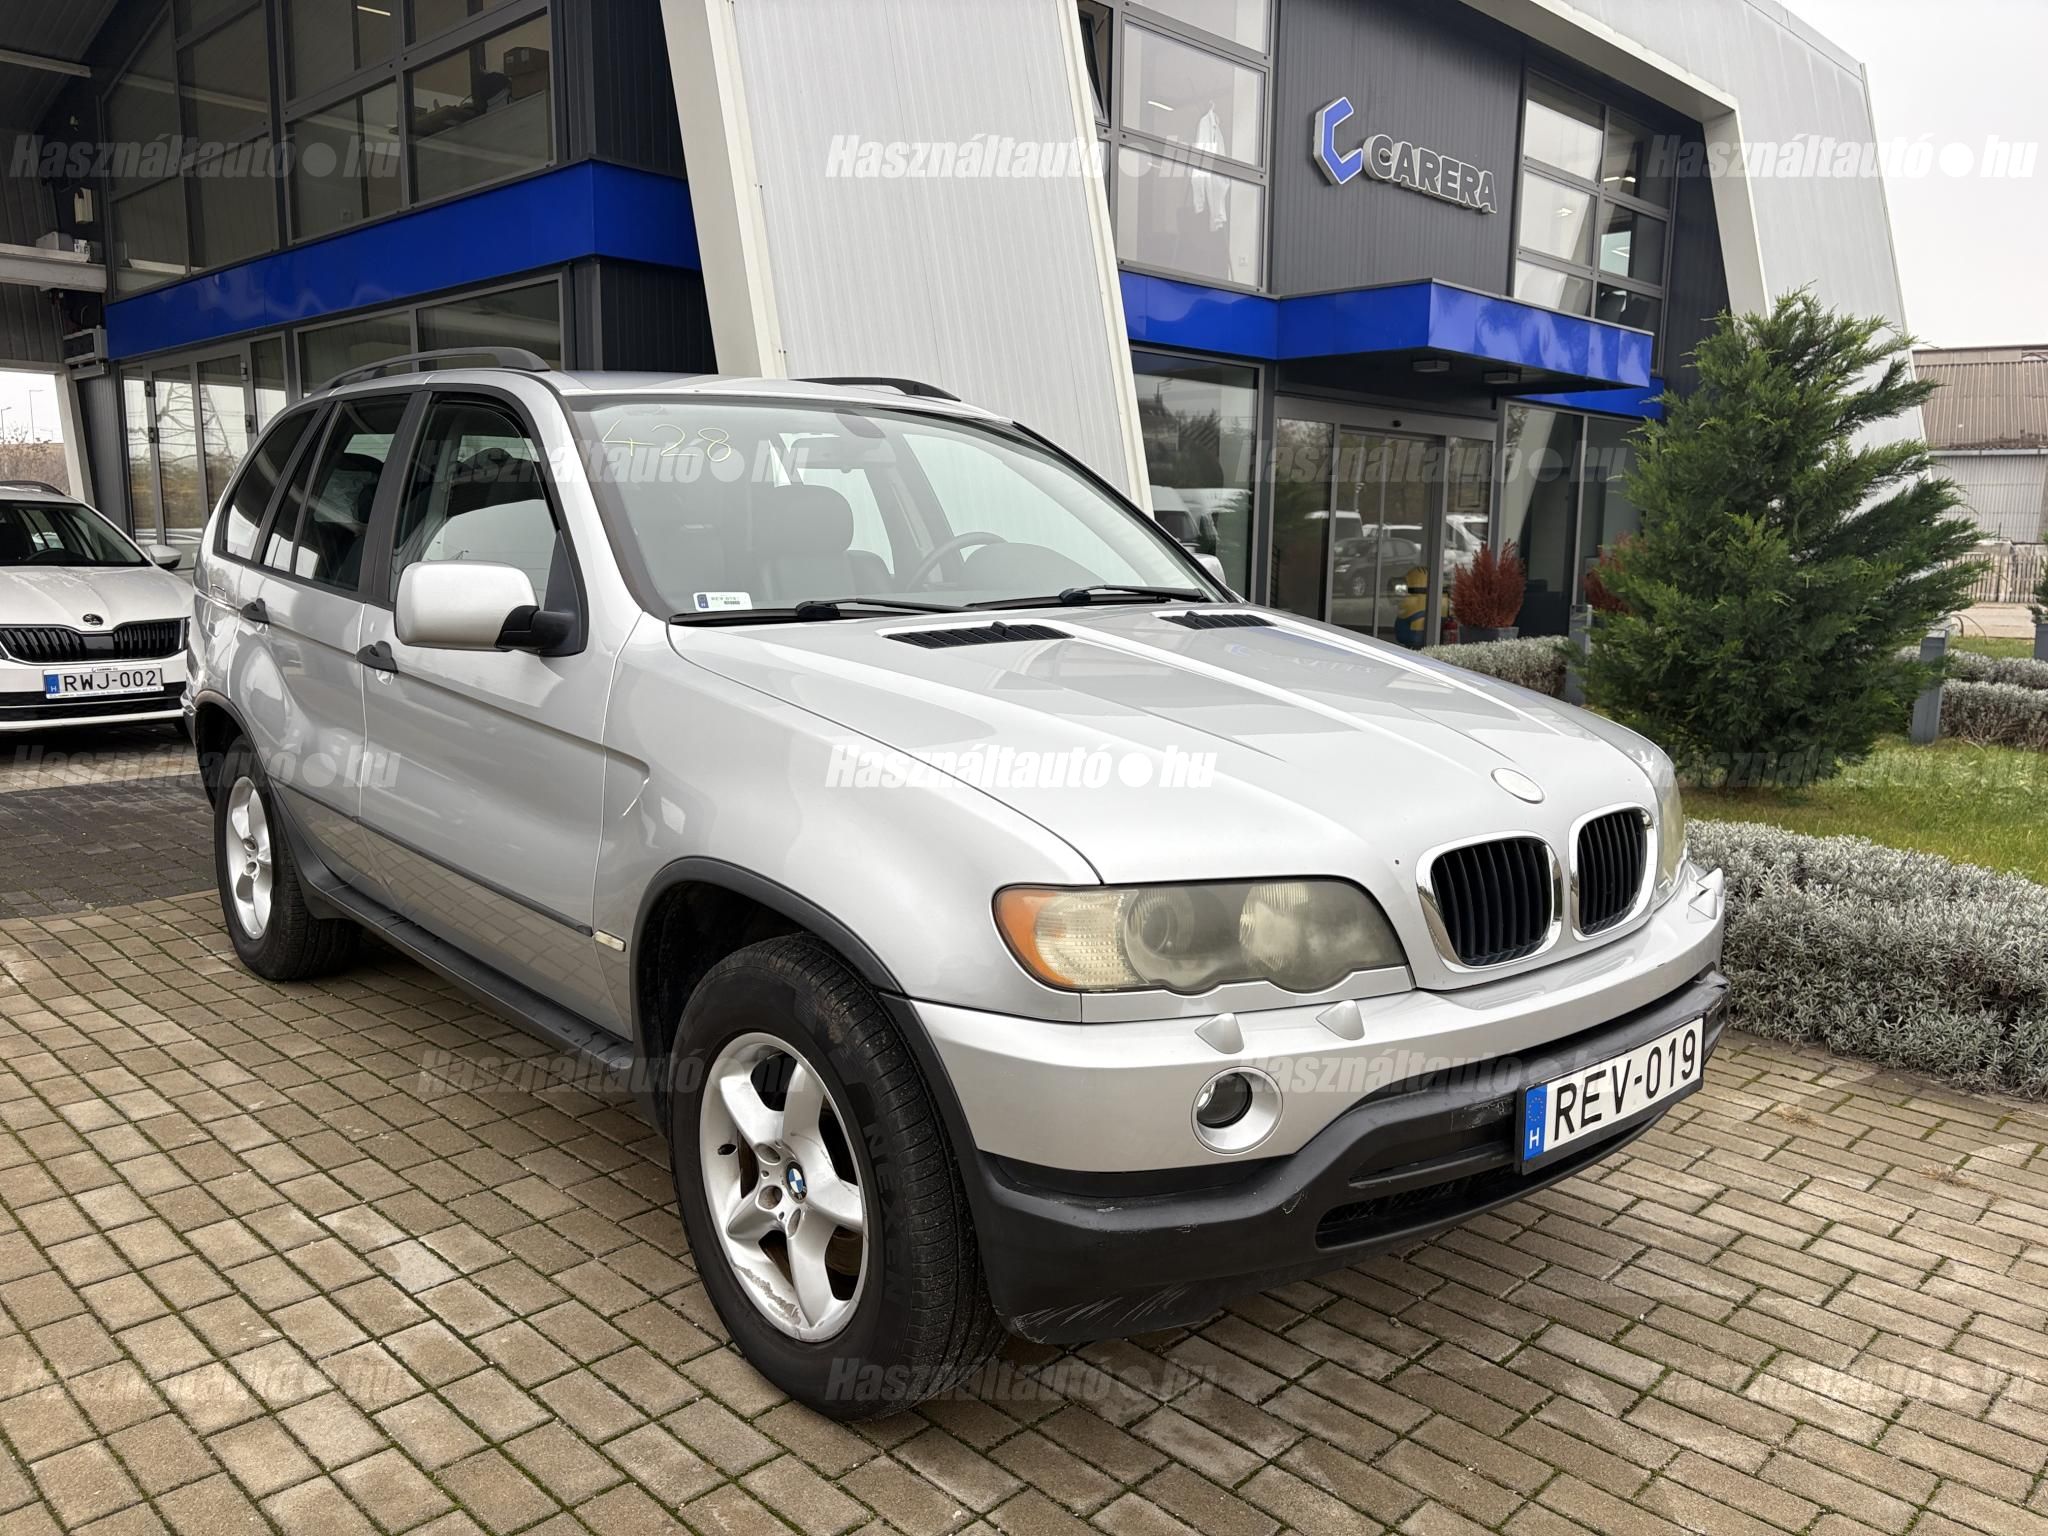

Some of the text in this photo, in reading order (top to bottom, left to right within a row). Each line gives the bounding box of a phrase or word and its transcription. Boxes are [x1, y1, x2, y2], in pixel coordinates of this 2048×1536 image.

[1363, 134, 1497, 214] CARERA
[602, 419, 732, 462] 428
[63, 670, 157, 692] RWJ-002
[1554, 1028, 1696, 1141] REV-019
[1529, 1127, 1540, 1150] H
